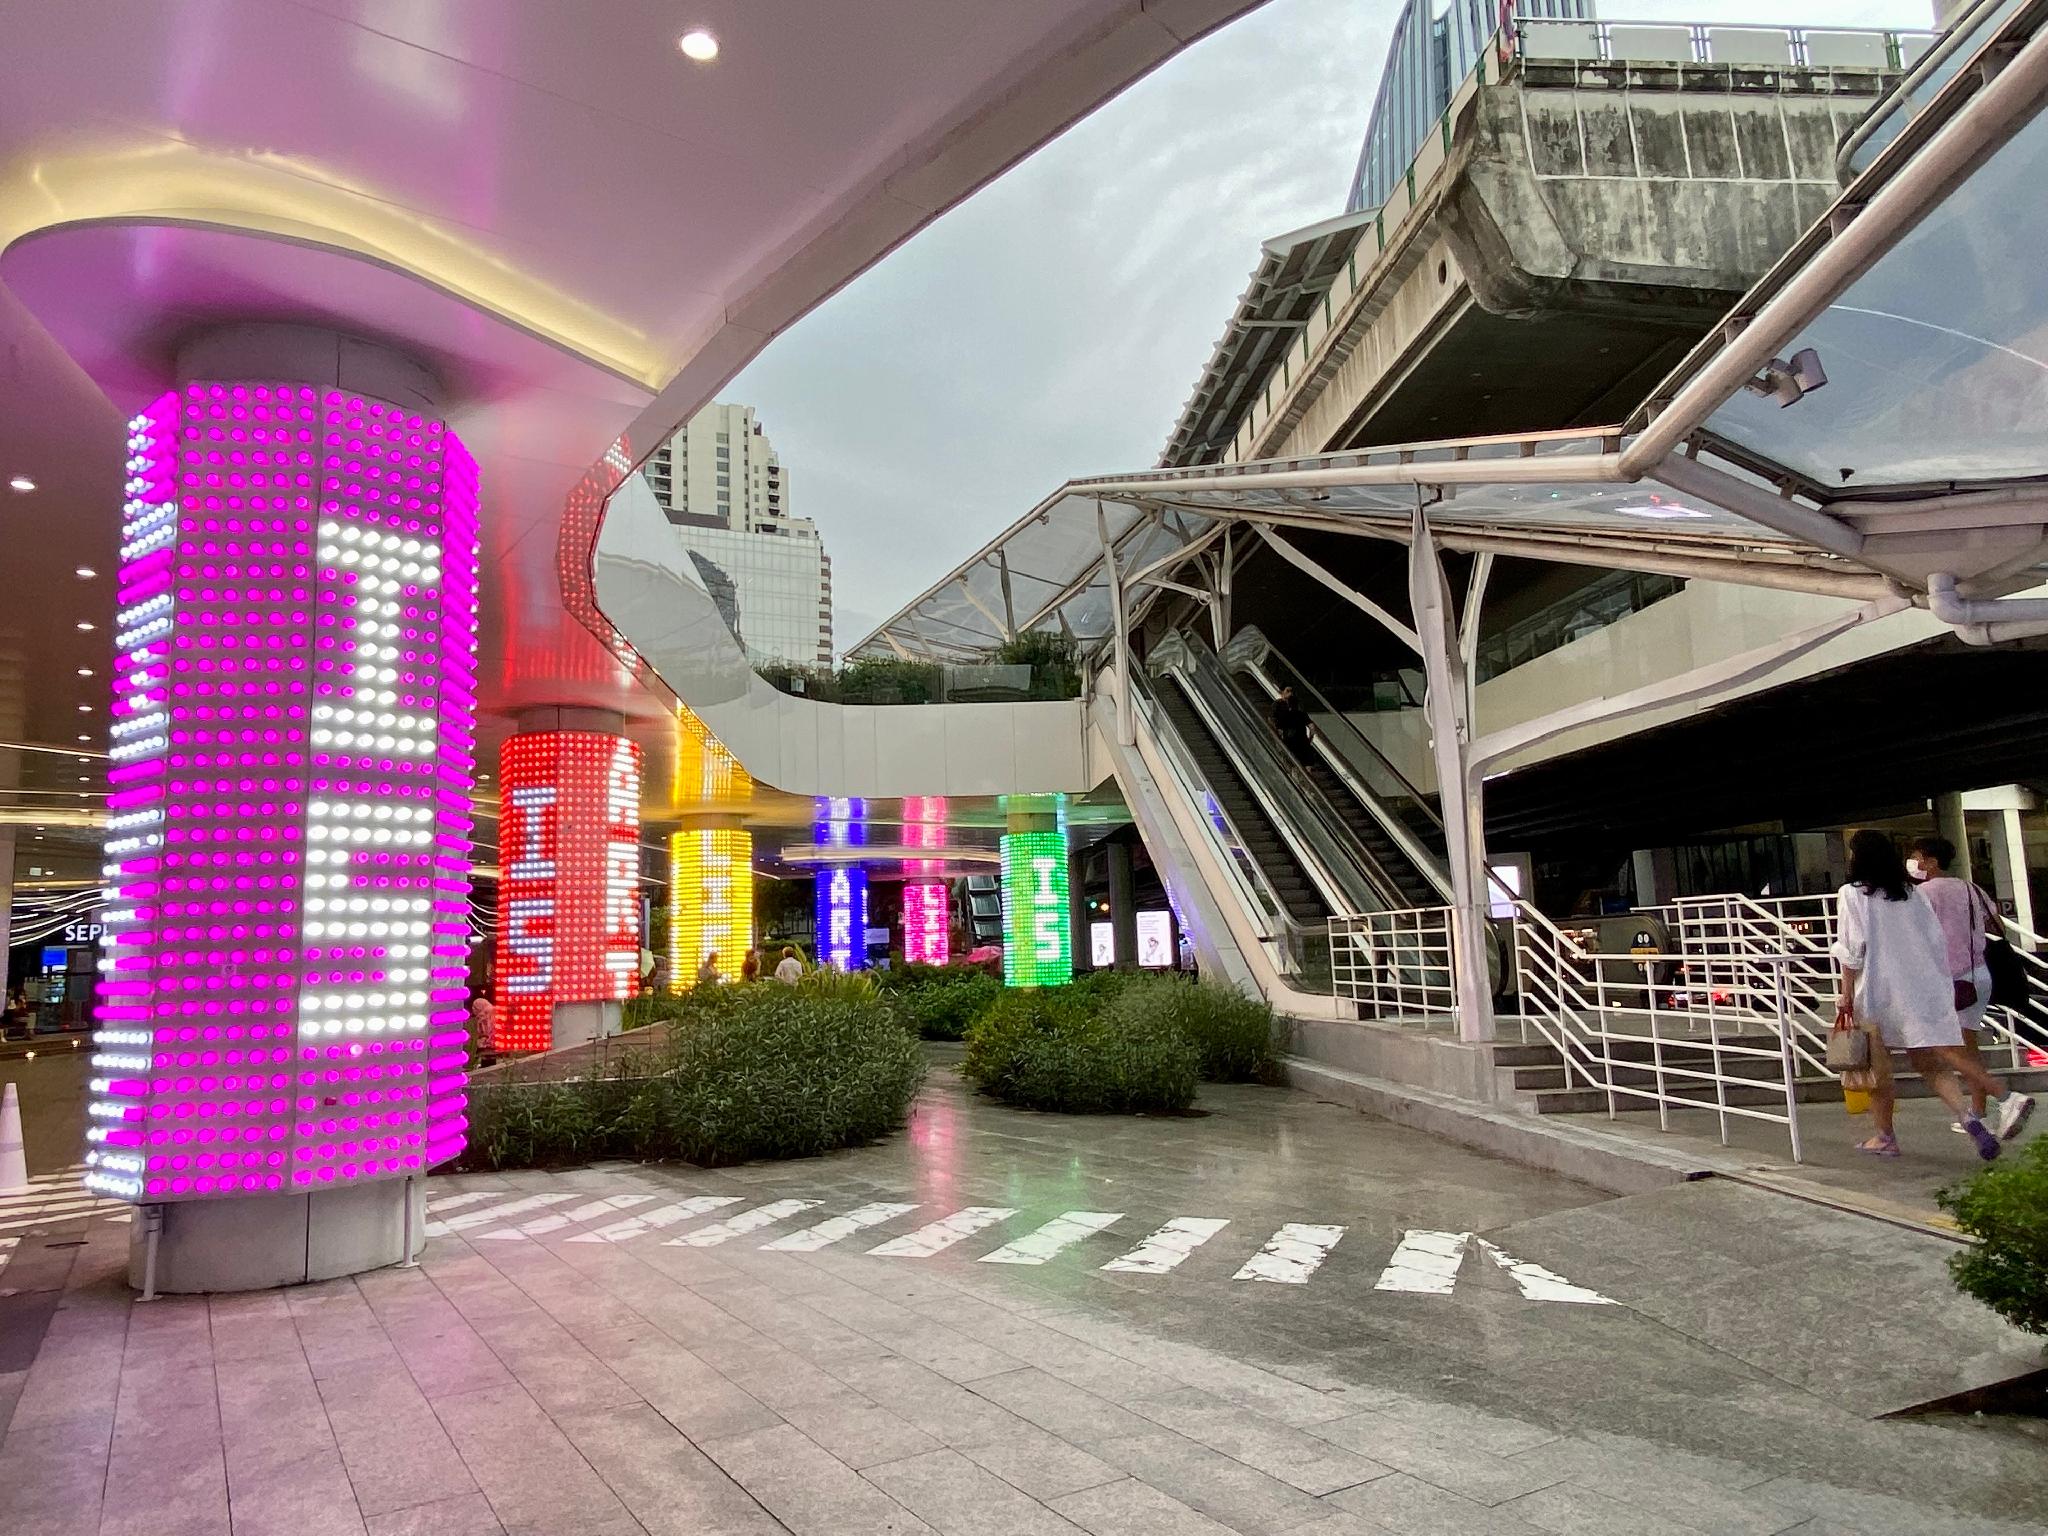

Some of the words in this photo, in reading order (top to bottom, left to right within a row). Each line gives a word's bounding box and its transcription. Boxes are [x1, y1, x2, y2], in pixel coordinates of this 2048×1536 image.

[301, 520, 441, 1036] IS
[508, 786, 556, 993] IS
[605, 737, 638, 999] ART
[1033, 858, 1060, 960] IS
